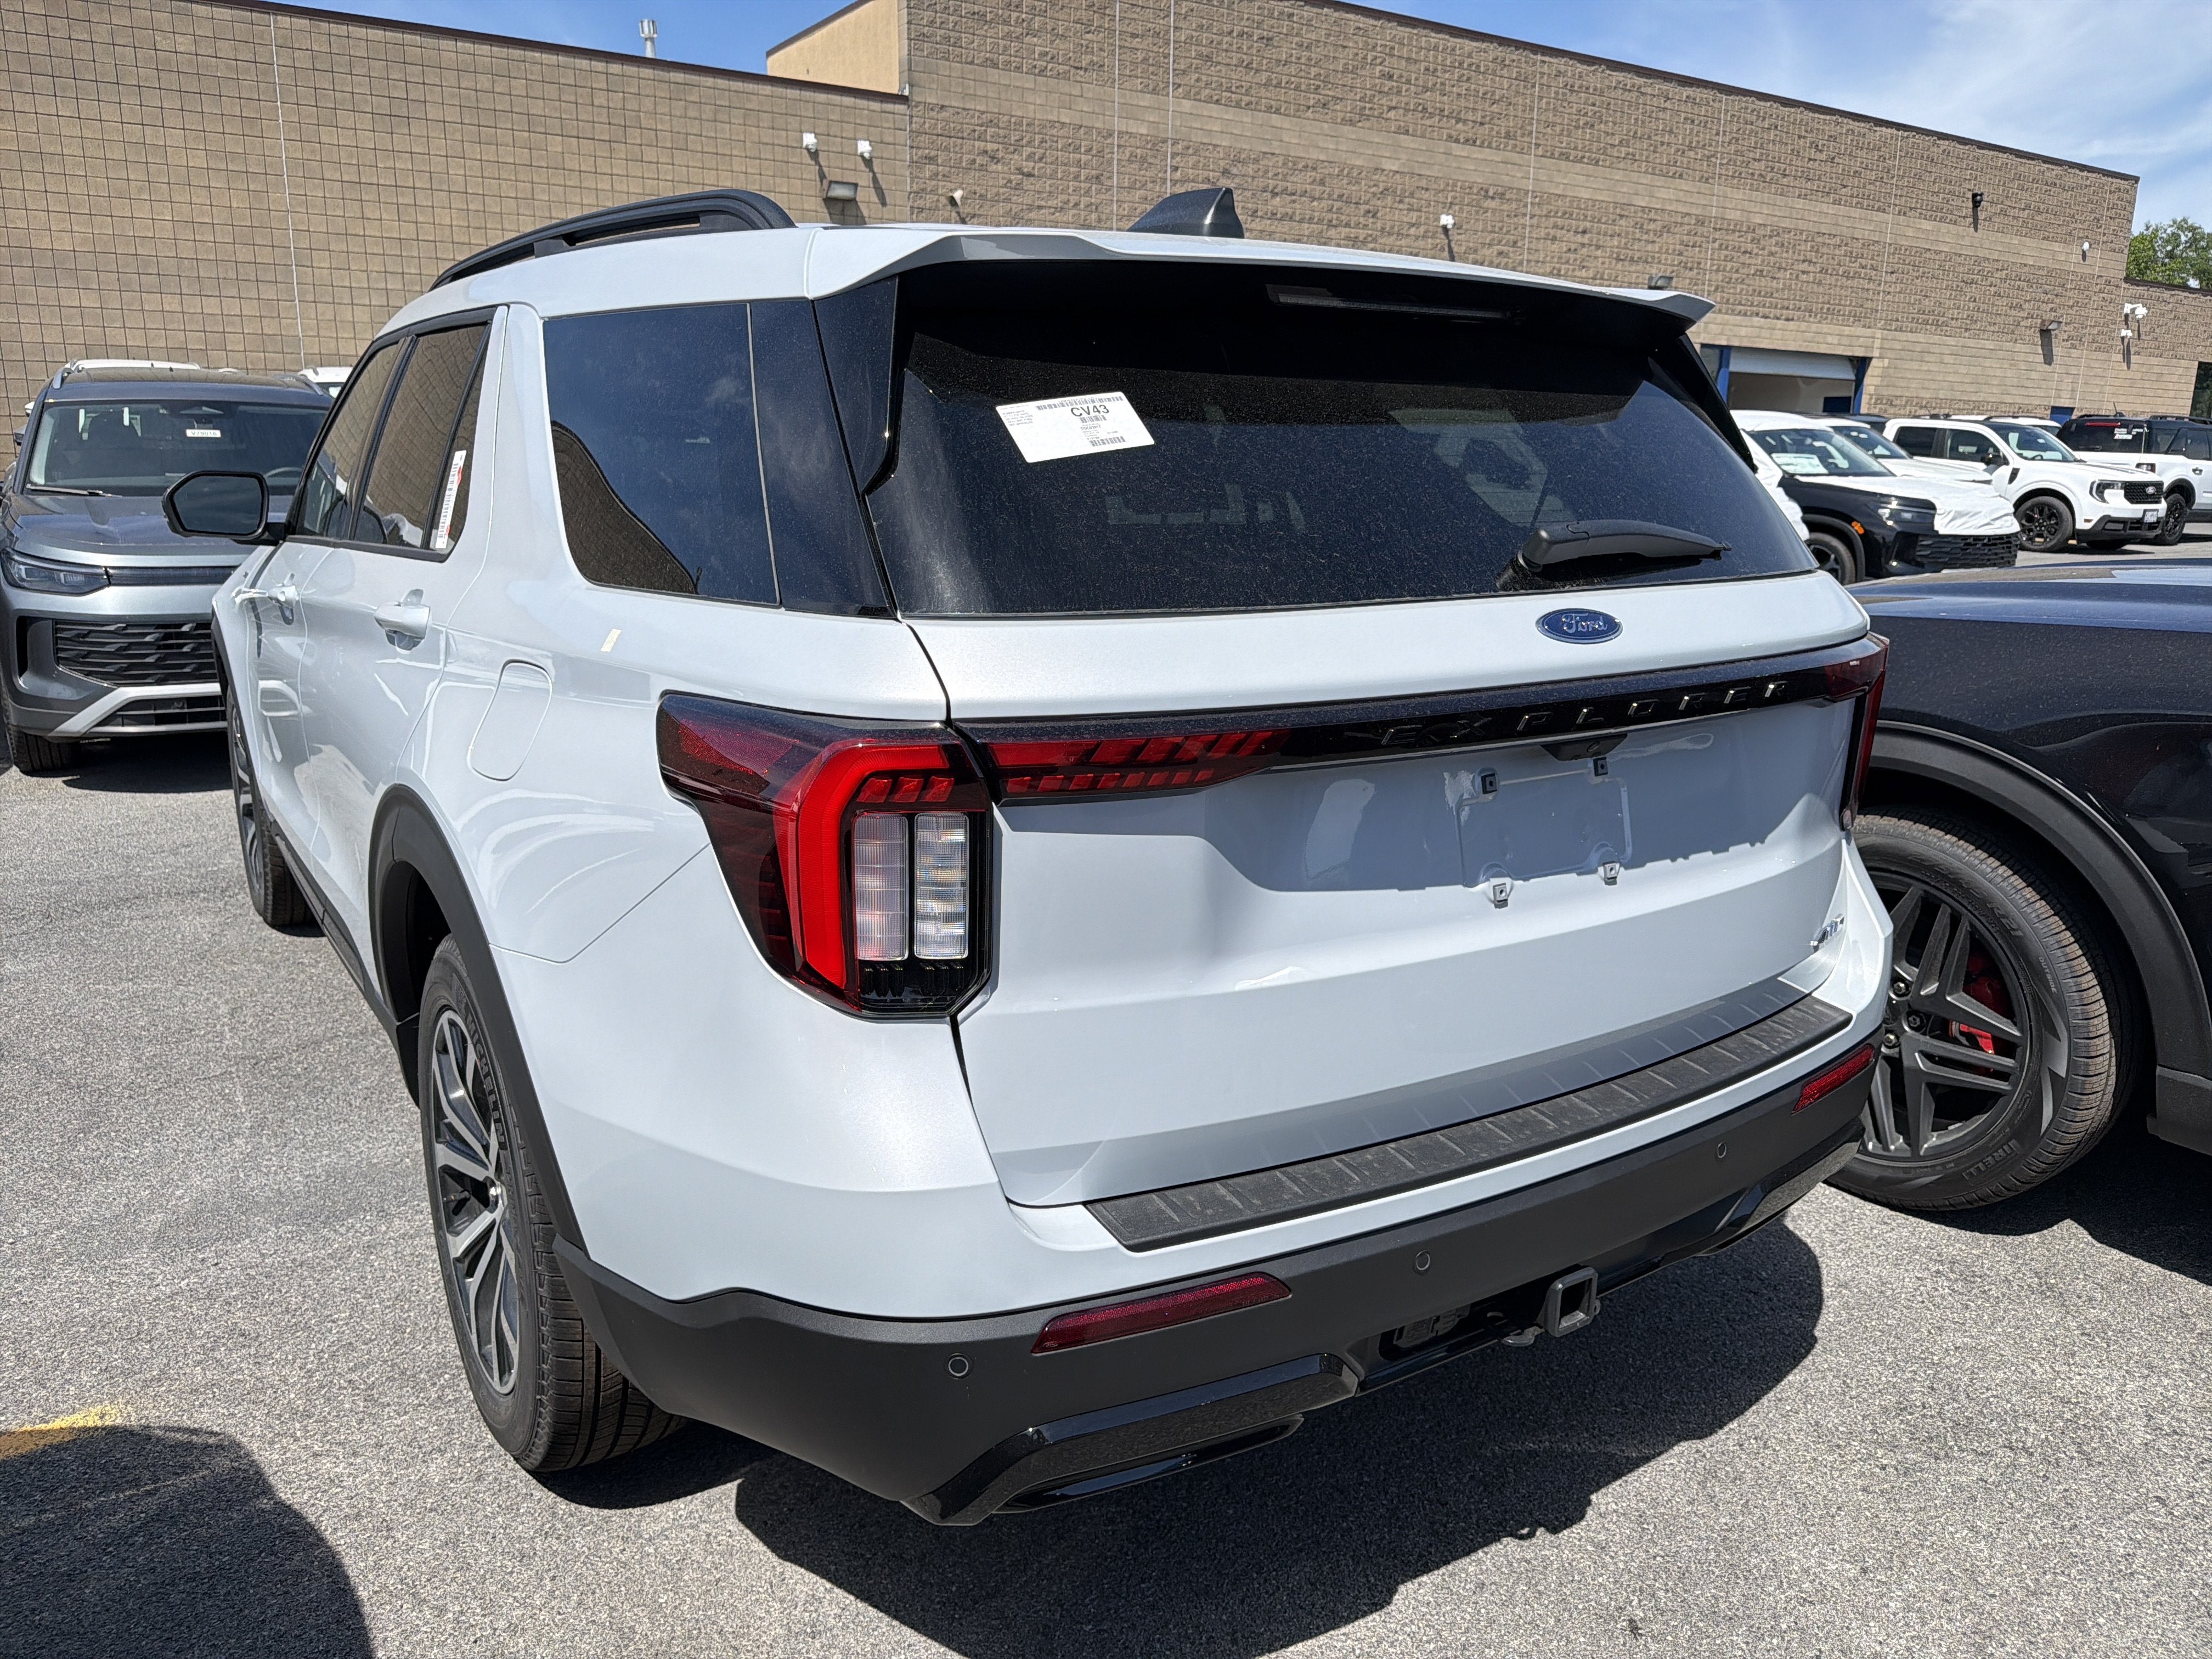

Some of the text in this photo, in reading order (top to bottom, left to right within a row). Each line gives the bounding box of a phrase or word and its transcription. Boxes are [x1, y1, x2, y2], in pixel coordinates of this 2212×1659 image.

[1070, 404, 1109, 417] CV43
[1561, 612, 1609, 634] Ford
[1381, 680, 1789, 746] EXPLORER
[2038, 956, 2057, 994] OUTSIDE
[467, 1014, 505, 1143] MICHELIN
